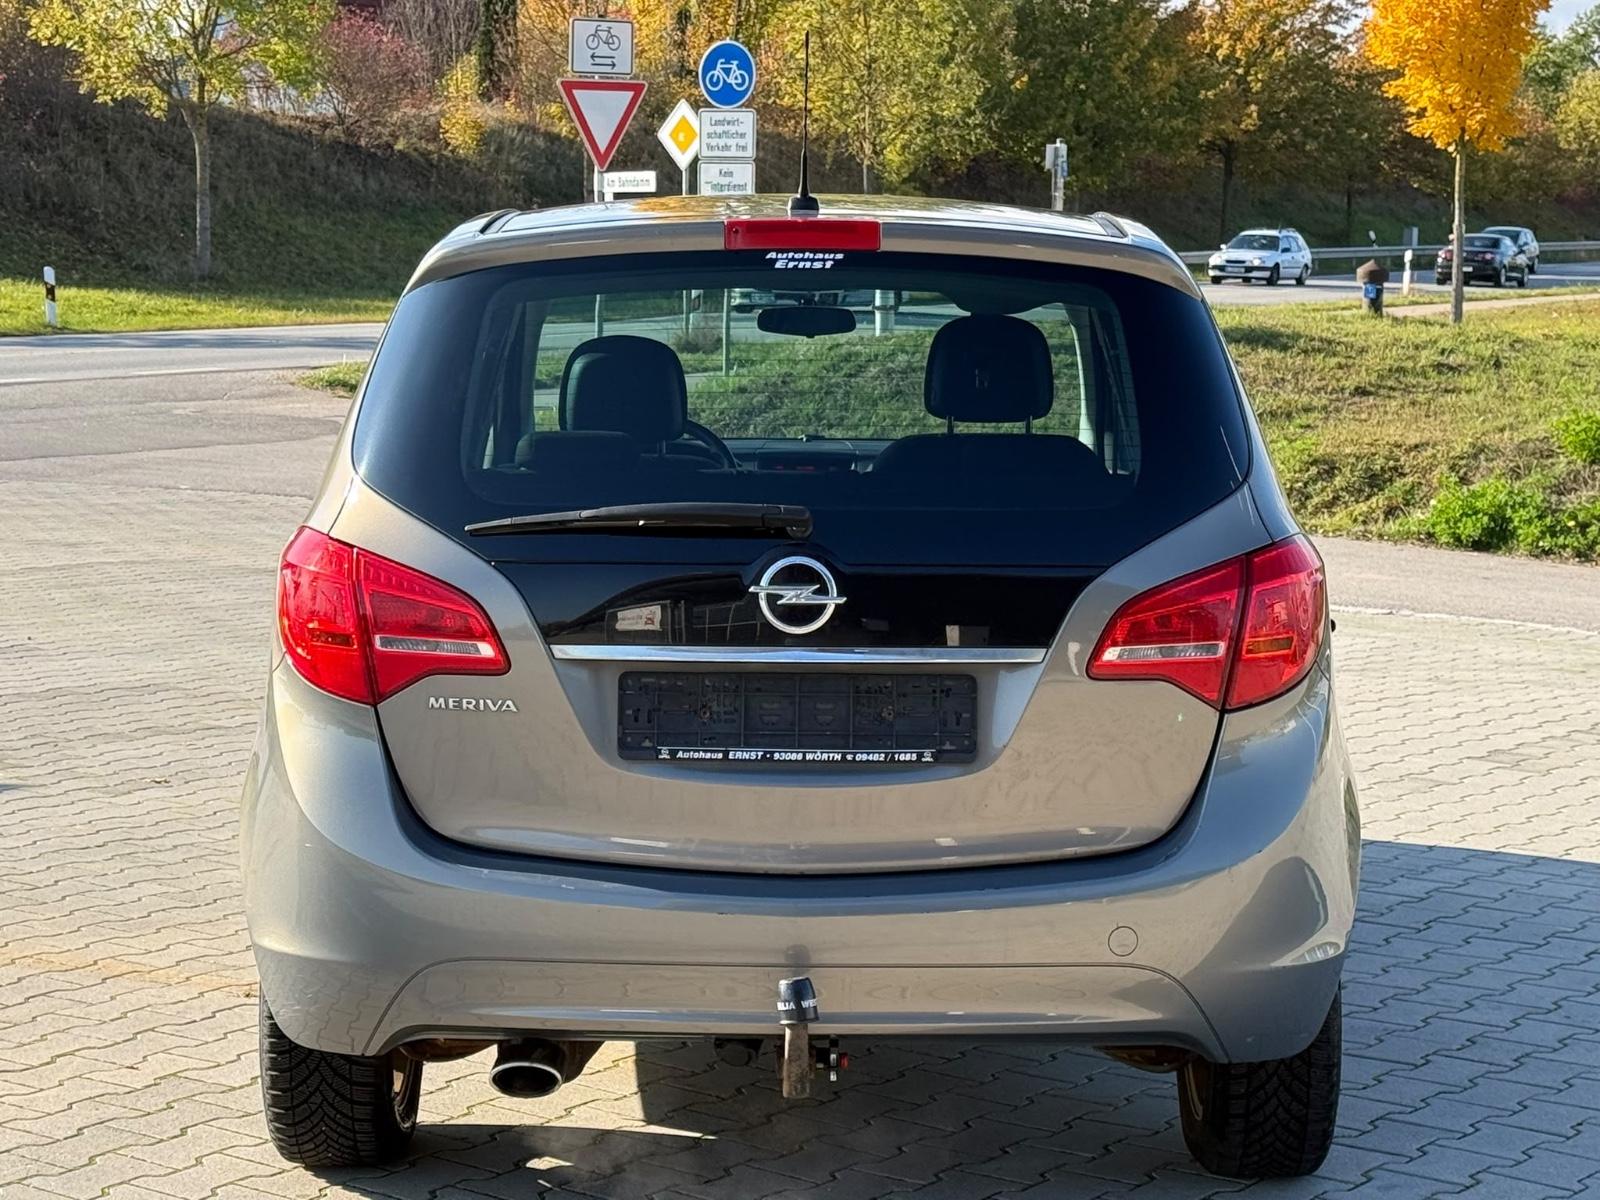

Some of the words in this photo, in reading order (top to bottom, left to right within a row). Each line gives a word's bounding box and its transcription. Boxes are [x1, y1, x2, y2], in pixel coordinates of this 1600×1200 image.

[709, 116, 744, 127] Landwirt-
[706, 130, 747, 139] schaftlicher
[706, 142, 732, 152] Verkehr
[735, 142, 748, 152] frei
[719, 168, 734, 178] Kein
[704, 181, 747, 192] interdienst
[765, 251, 845, 260] Autohaus
[774, 259, 834, 269] Ernst
[428, 696, 518, 713] MERIVA
[676, 749, 724, 760] Autohaus
[728, 750, 764, 761] ERNST
